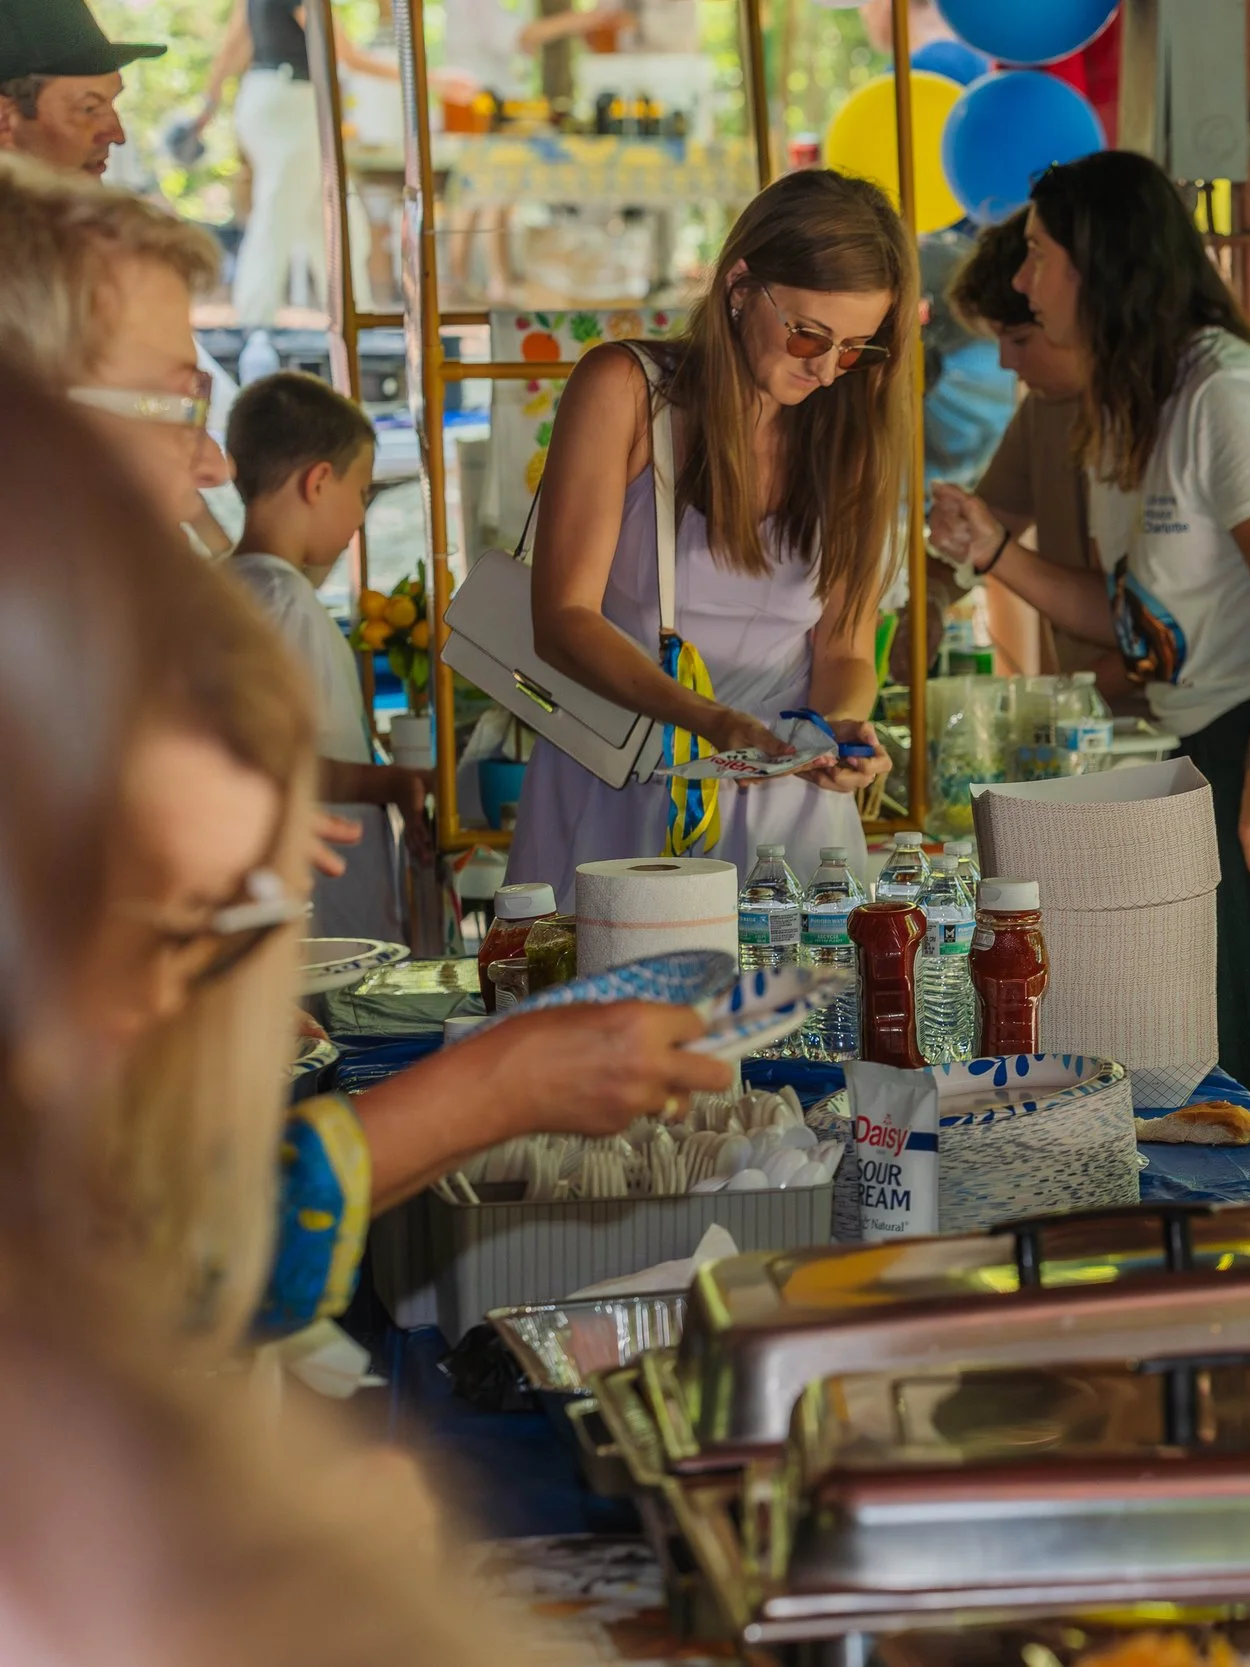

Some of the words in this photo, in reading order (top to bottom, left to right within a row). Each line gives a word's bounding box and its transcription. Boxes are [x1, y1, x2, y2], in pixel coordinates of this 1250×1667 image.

[855, 1115, 908, 1157] Daisy
[857, 1159, 902, 1186] SOUR
[858, 1183, 911, 1211] REAM
